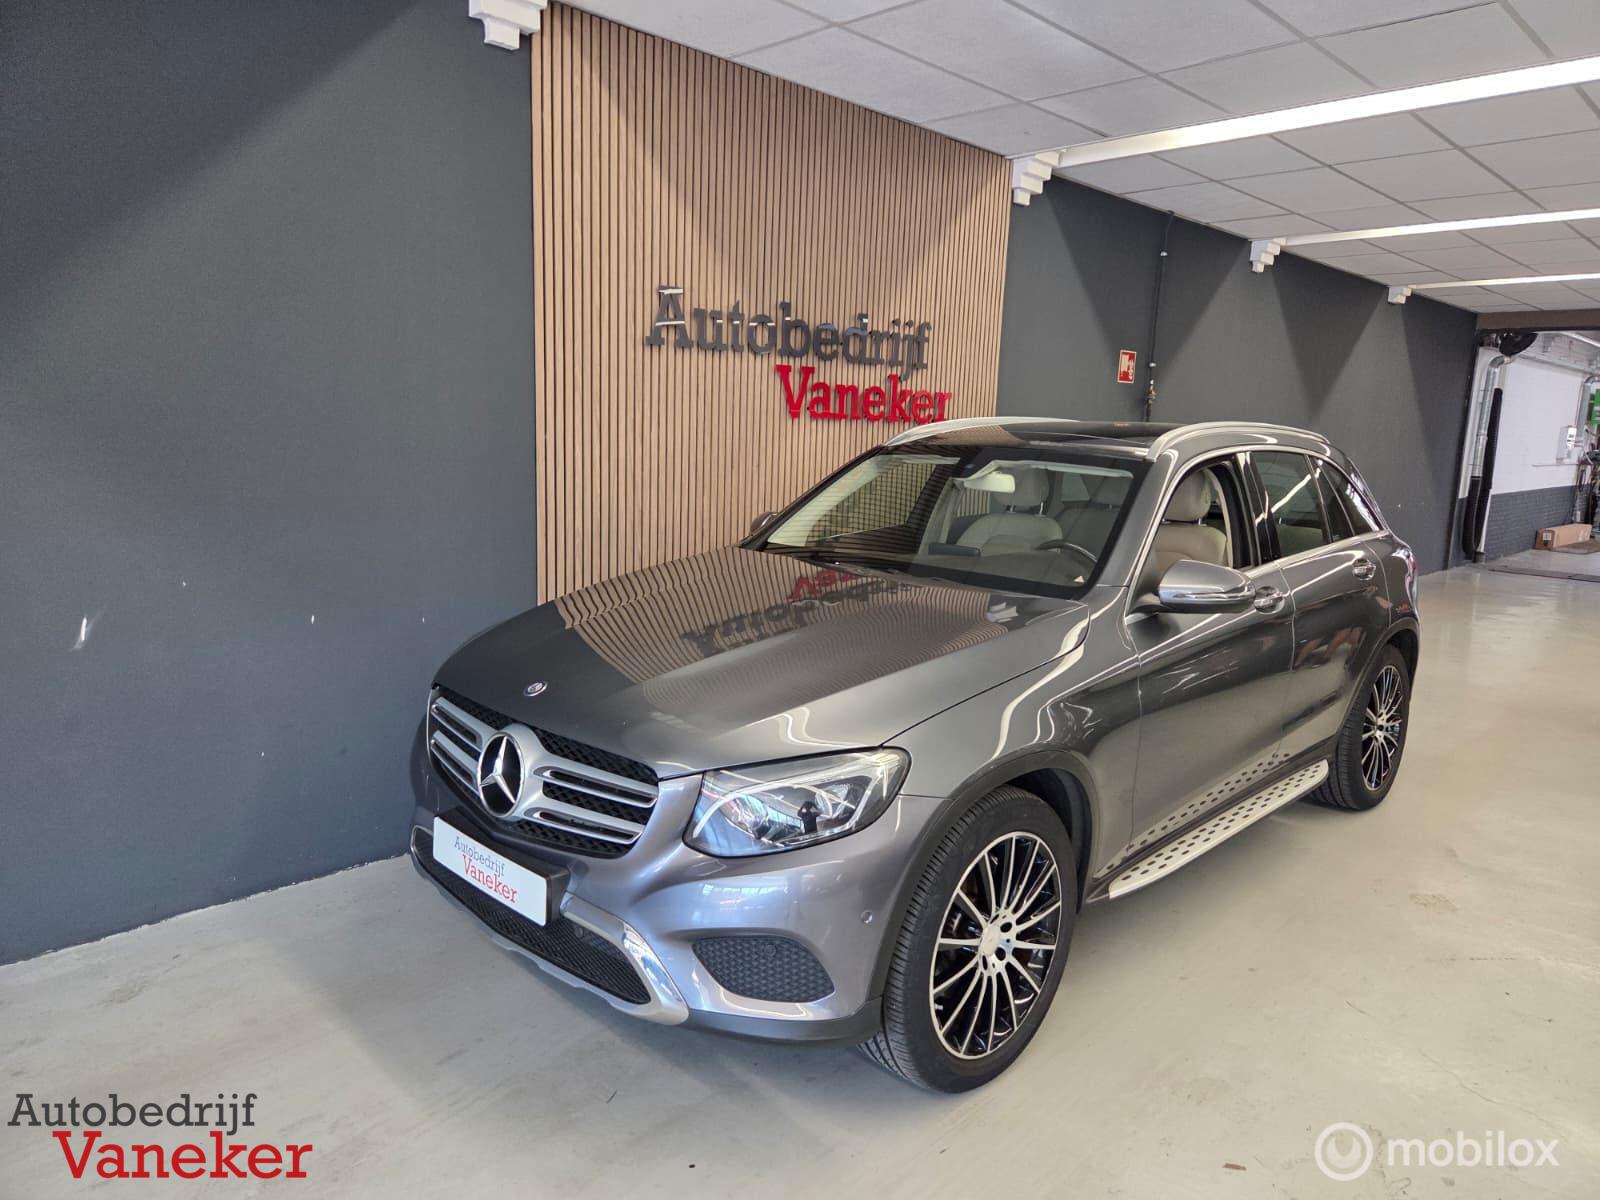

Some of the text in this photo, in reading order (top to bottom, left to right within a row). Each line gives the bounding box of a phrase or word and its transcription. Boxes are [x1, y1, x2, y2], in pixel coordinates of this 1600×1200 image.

[645, 285, 932, 382] Autobedrijf
[775, 364, 952, 425] Vaneker
[454, 836, 505, 877] Autobedrijf
[462, 854, 518, 903] Vaneker
